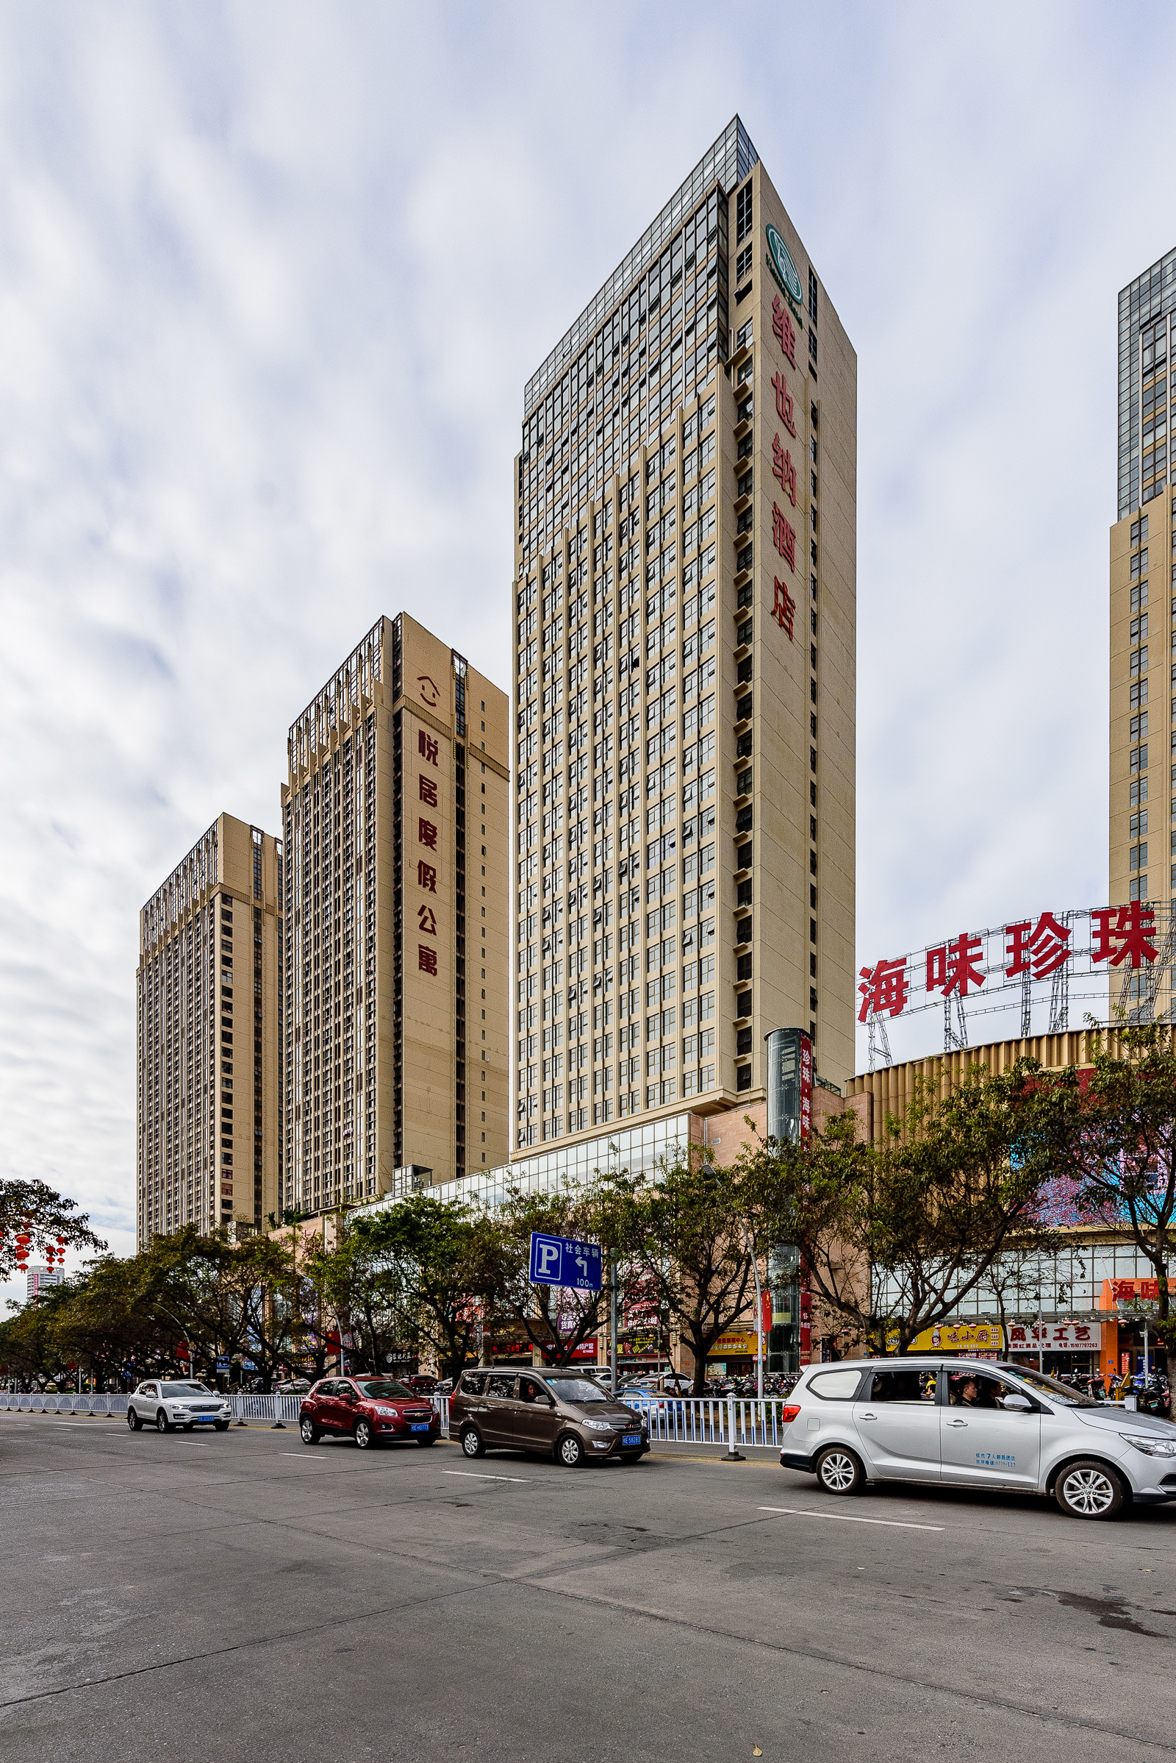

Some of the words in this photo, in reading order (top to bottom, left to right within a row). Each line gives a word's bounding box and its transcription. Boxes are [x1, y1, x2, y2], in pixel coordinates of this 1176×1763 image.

[771, 294, 796, 640] 维也纳酒店
[417, 729, 439, 976] 悦居度假公寓
[857, 900, 1159, 1023] 海味珍珠
[538, 1244, 558, 1274] P
[565, 1242, 599, 1258] 社会车辆
[1010, 1326, 1091, 1342] 风华工艺
